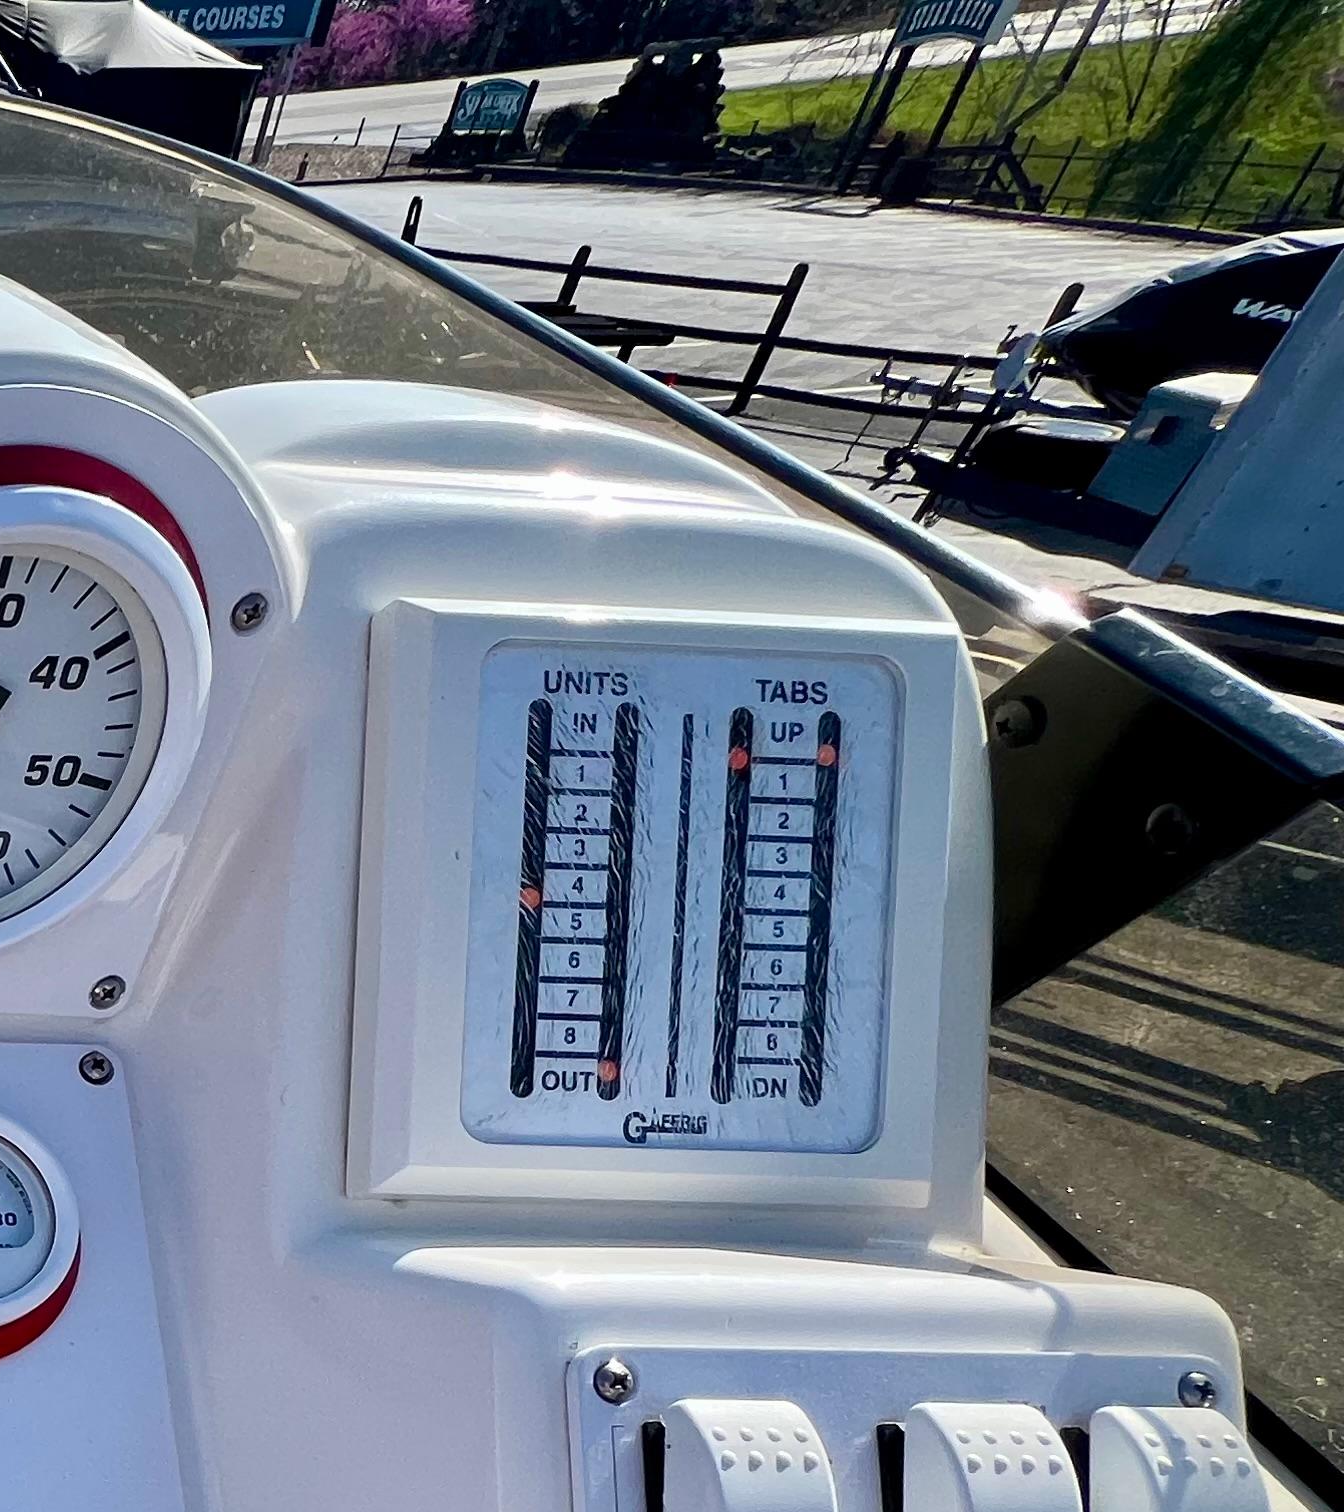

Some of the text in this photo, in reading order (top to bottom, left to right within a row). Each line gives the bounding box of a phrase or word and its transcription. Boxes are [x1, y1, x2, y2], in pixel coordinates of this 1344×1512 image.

[192, 4, 285, 31] COURSES
[29, 655, 90, 690] 40
[544, 670, 628, 696] UNITS
[756, 679, 829, 704] TABS
[573, 712, 597, 734] IN
[771, 721, 805, 744] UP
[24, 755, 81, 787] 50
[576, 766, 585, 782] 1
[778, 774, 788, 791] 1
[575, 804, 587, 823] 2
[777, 813, 790, 830] 2
[574, 839, 586, 858] 3
[775, 847, 788, 865] 3
[571, 876, 585, 895] 4
[773, 884, 787, 901] 4
[569, 913, 583, 931] 5
[771, 921, 785, 938] 5
[568, 951, 581, 970] 6
[769, 958, 783, 976] 6
[566, 990, 578, 1008] 7
[768, 997, 780, 1015] 7
[563, 1027, 576, 1046] 8
[541, 1070, 593, 1093] OUT
[752, 1077, 787, 1098] DN
